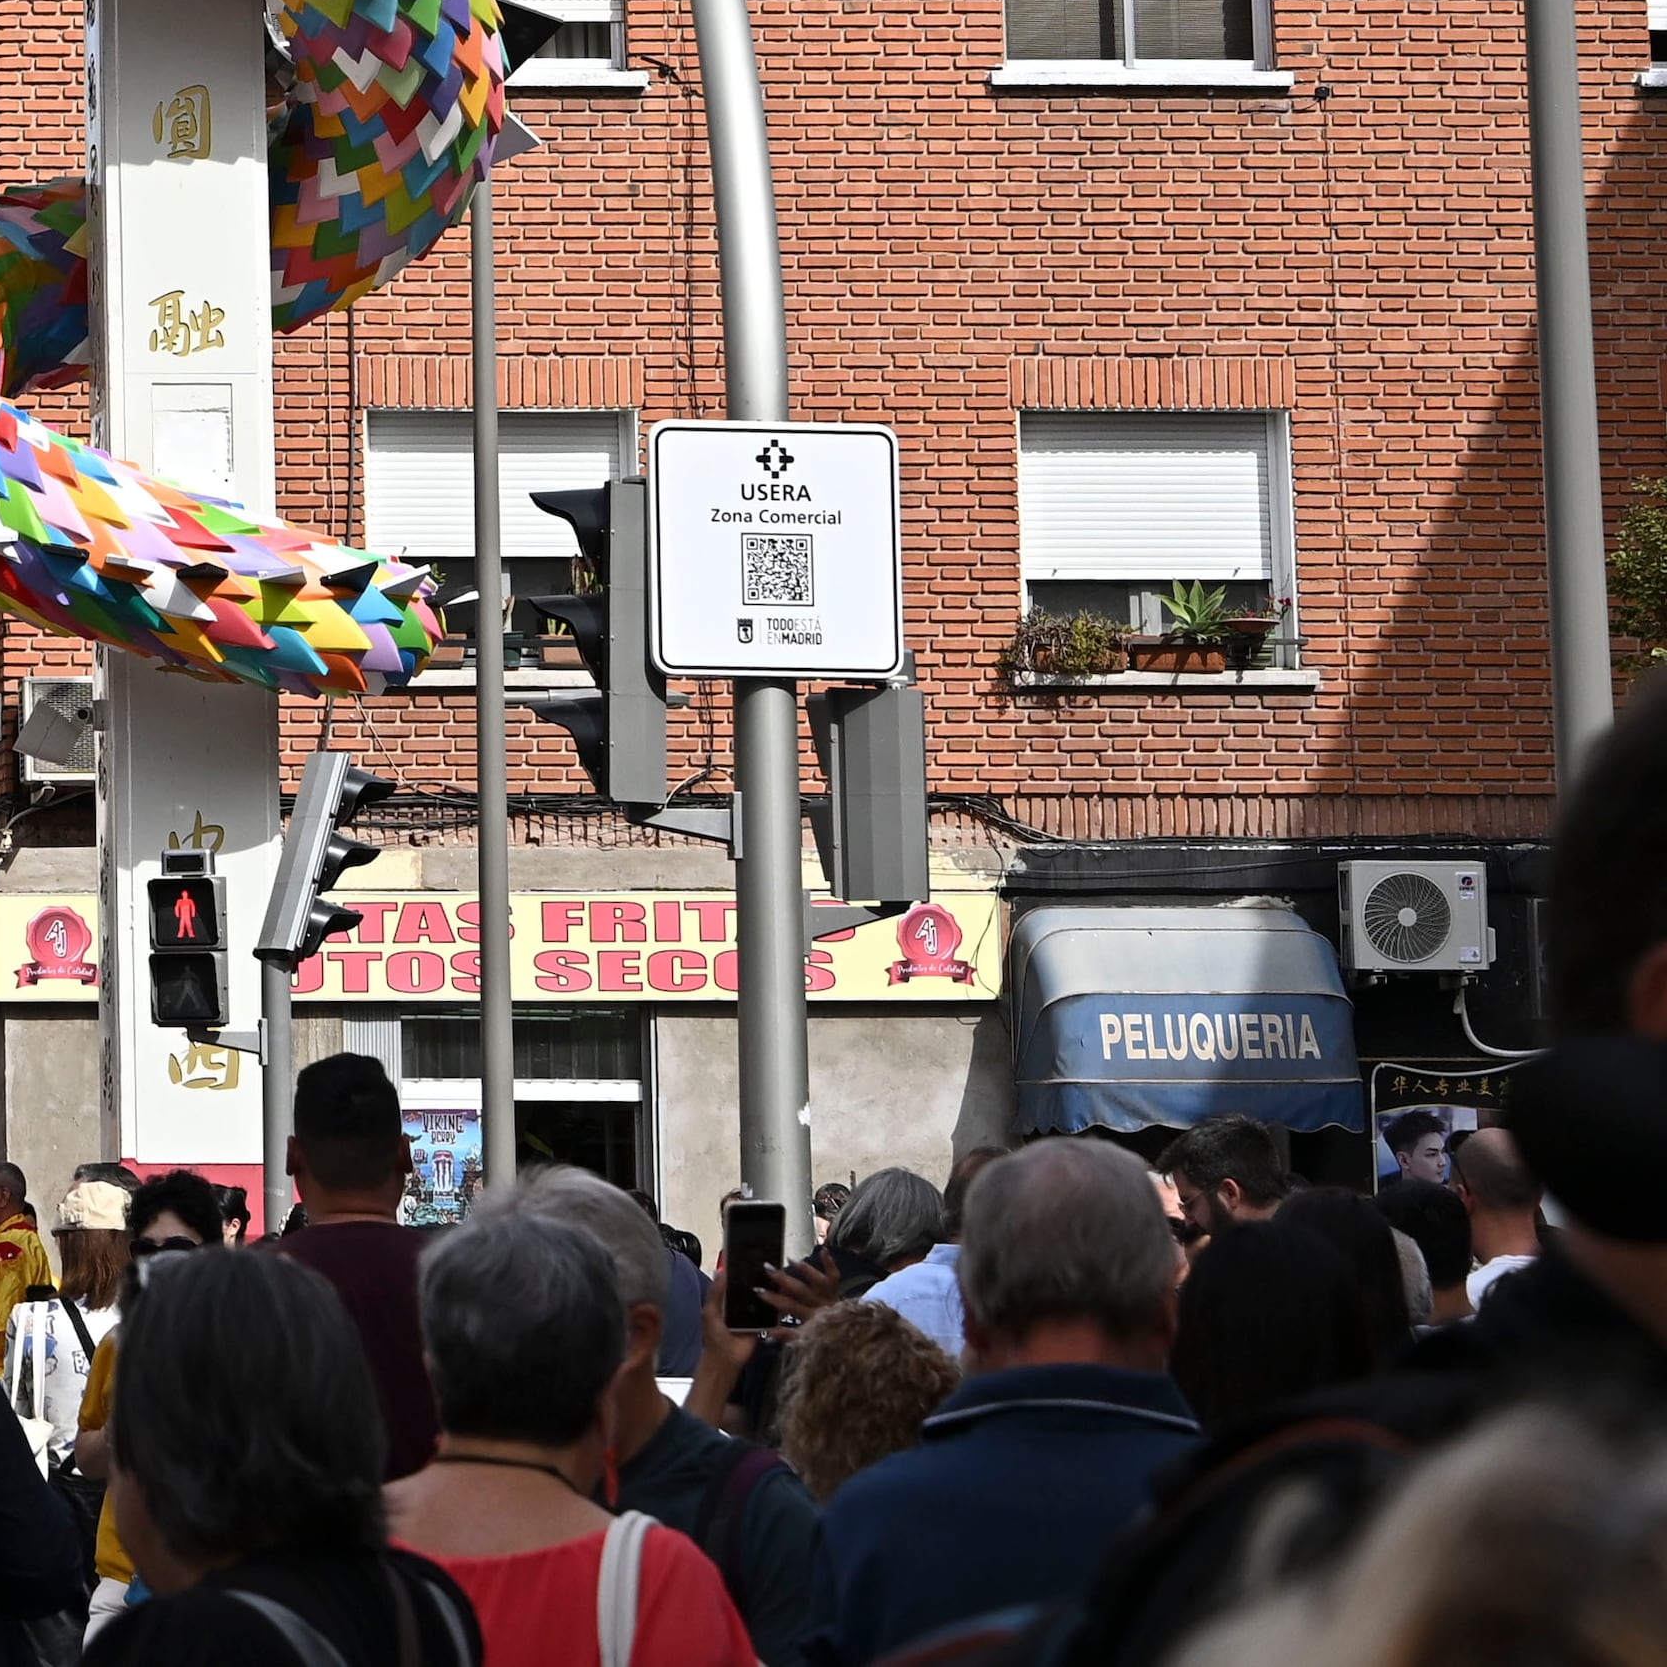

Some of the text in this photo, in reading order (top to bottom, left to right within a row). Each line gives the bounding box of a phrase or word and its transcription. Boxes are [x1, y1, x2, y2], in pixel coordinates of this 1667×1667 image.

[740, 483, 812, 501] USERA
[710, 508, 841, 525] Zona Comercial
[1100, 1012, 1322, 1061] PELUQUERIA
[422, 1114, 465, 1133] VIKING
